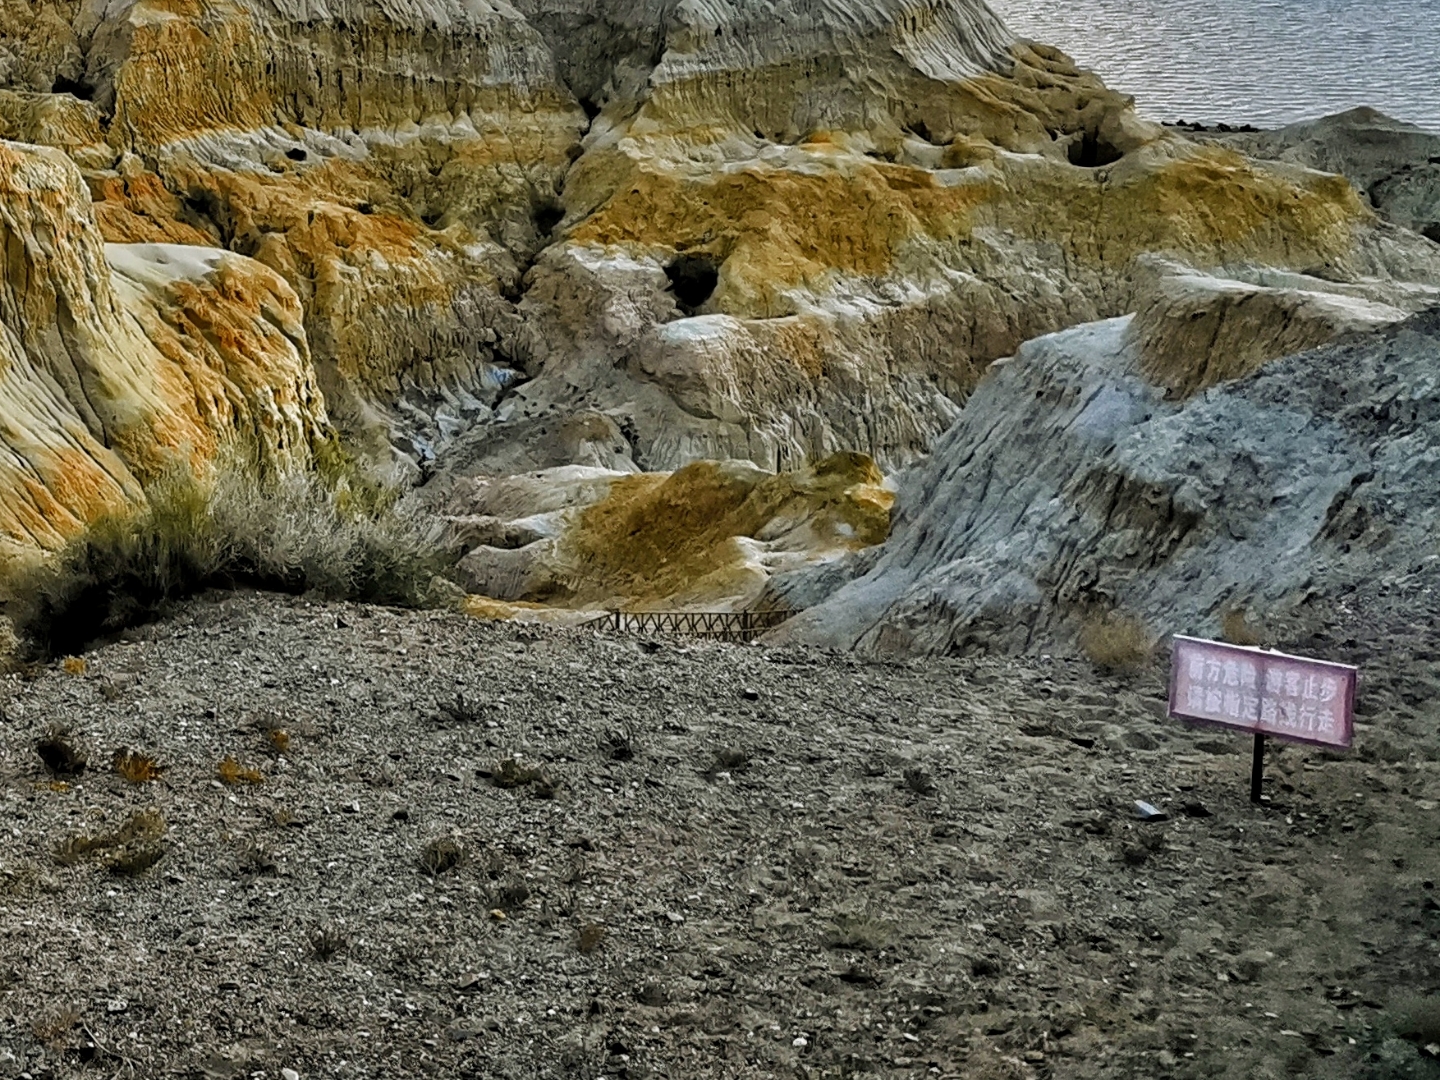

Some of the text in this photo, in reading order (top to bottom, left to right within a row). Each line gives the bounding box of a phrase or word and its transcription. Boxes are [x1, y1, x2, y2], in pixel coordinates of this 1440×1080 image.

[1188, 653, 1338, 702] 前方危险 游客止步
